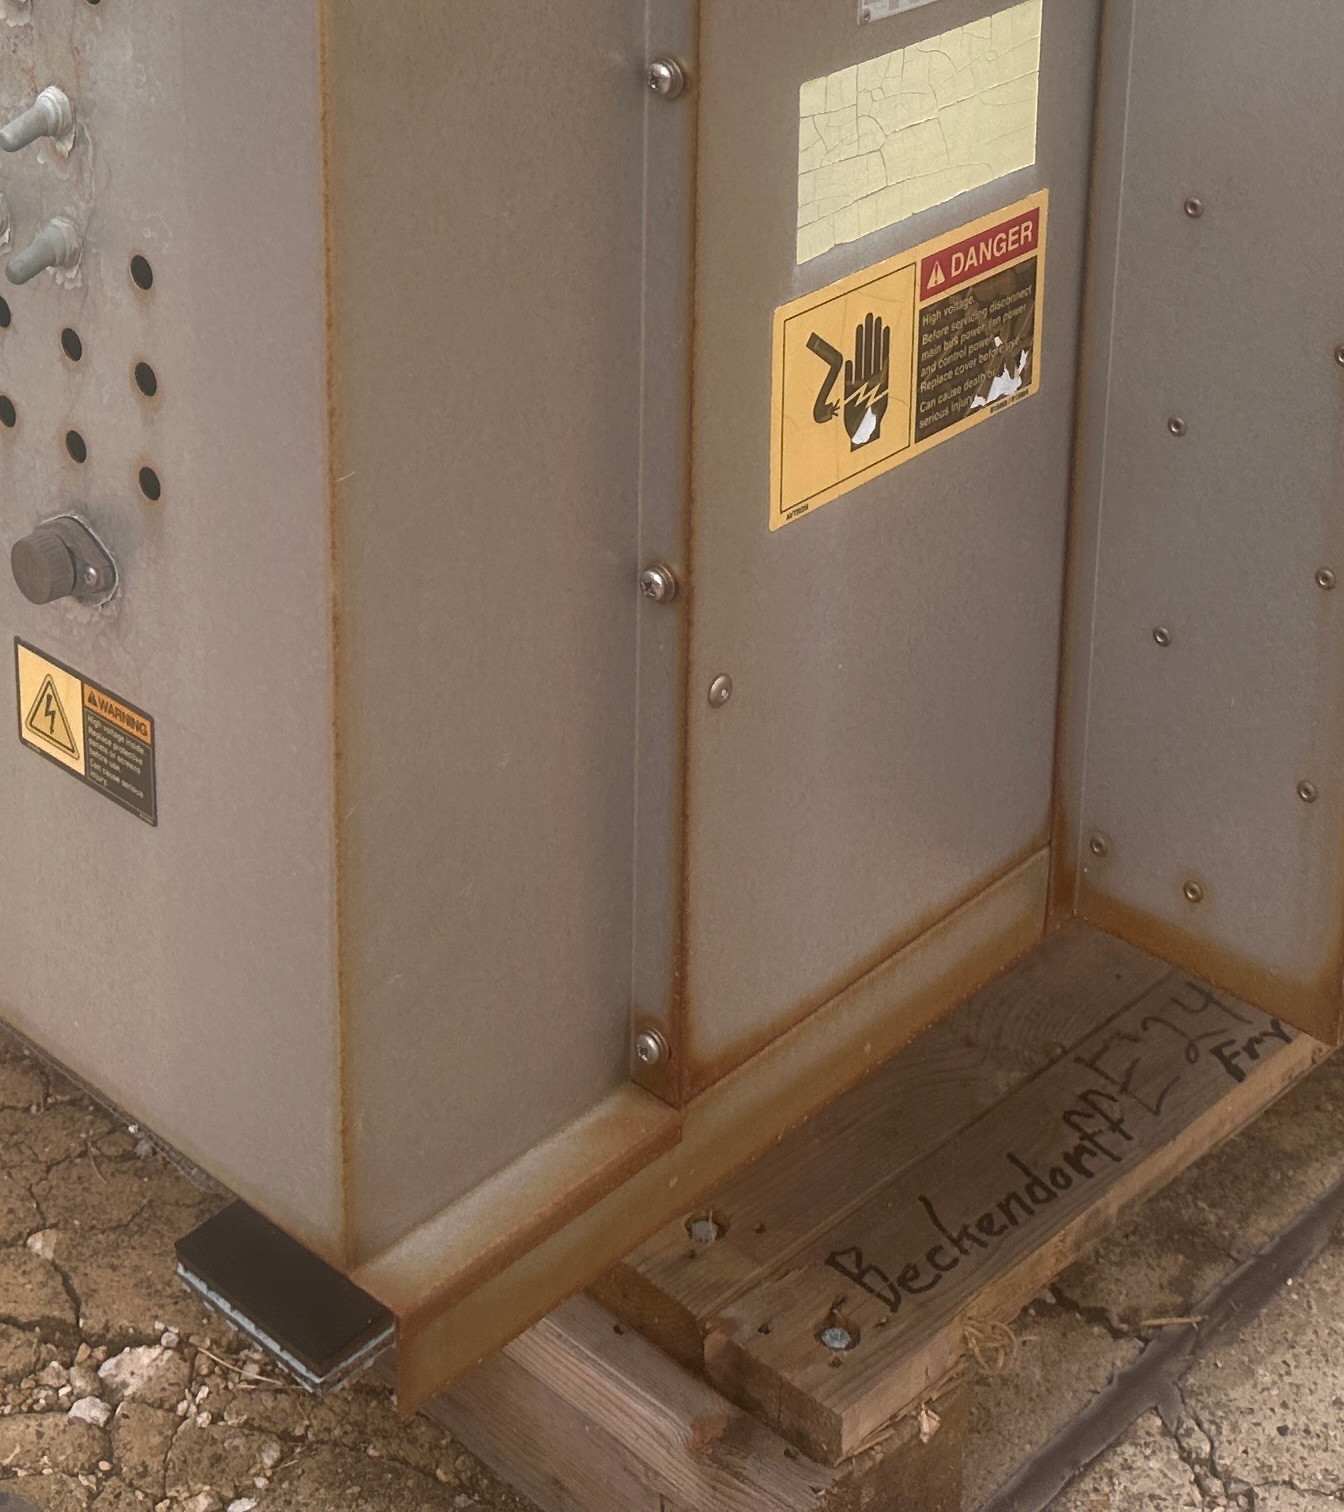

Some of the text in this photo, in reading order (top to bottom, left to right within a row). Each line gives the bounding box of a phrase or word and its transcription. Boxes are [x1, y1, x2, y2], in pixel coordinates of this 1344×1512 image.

[950, 220, 1033, 278] DANGER
[922, 325, 949, 346] Before
[989, 284, 1032, 313] disconnect
[922, 309, 942, 327] High
[920, 362, 937, 378] and
[938, 347, 967, 368] control
[921, 345, 942, 361] main
[920, 369, 954, 393] Replace
[955, 358, 978, 376] cover
[920, 398, 936, 413] Can
[937, 385, 962, 404] cause
[919, 406, 950, 428] serious
[97, 699, 148, 738] WARNING
[823, 1088, 1134, 1314] Beckendorff
